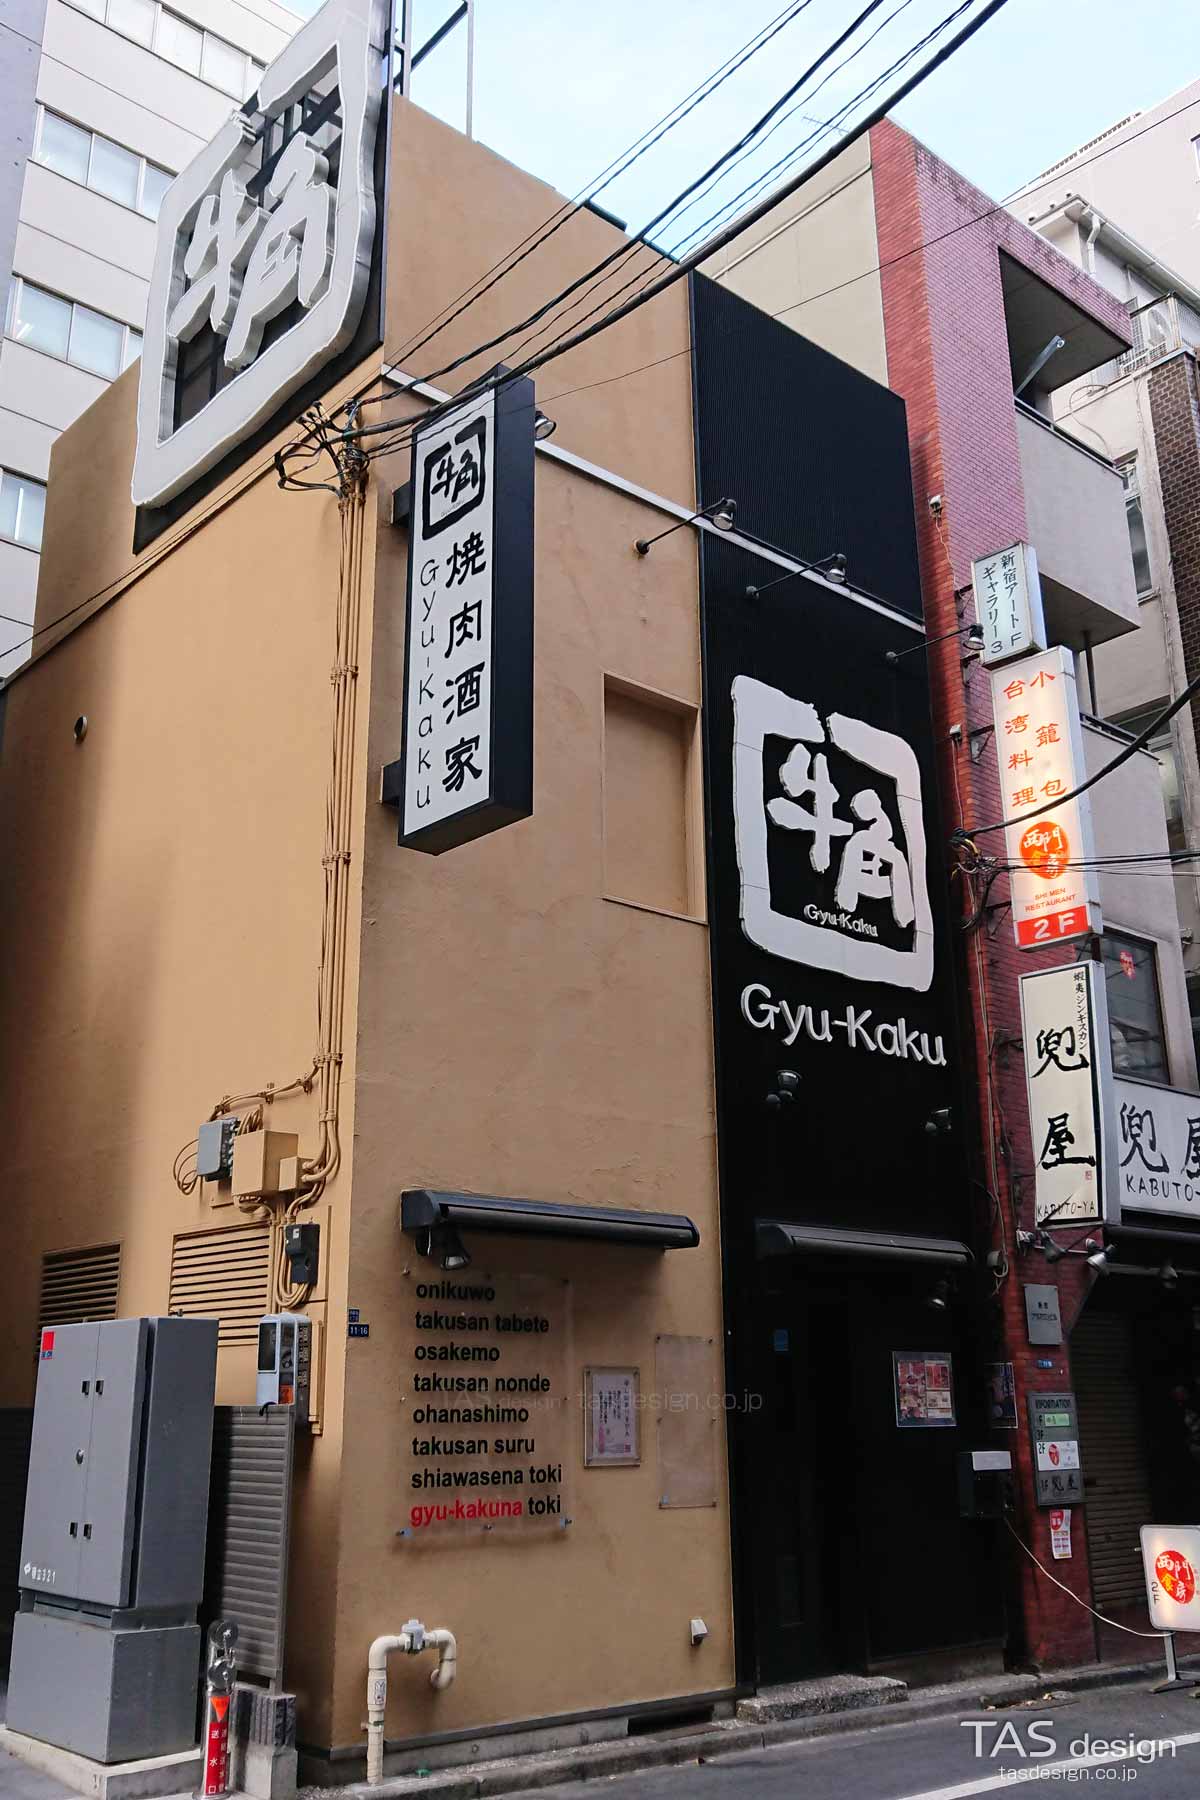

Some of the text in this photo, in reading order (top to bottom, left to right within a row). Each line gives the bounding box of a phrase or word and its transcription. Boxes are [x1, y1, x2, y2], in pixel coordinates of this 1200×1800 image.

[166, 131, 336, 368] 牛角
[431, 449, 478, 502] 牛角
[983, 563, 999, 638] ギャラリー
[1001, 552, 1020, 628] 新宿アート
[443, 532, 487, 792] 焼肉酒家
[1003, 680, 1037, 807] 台湾料理
[1030, 671, 1067, 797] 小籠包
[767, 742, 915, 928] 牛角
[804, 903, 878, 937] Gyu-Kaku
[1025, 895, 1076, 912] RESTAURANT
[740, 983, 947, 1066] Gyu-Kaku
[1030, 1026, 1096, 1170] 兜屋
[416, 1281, 495, 1300] onikuwo
[415, 1311, 549, 1333] takusan tabete
[415, 1342, 500, 1361] osakemo
[414, 1372, 550, 1392] takusan nonde
[413, 1404, 529, 1423] ohanashimo
[412, 1436, 535, 1456] takusan suru
[411, 1464, 562, 1488] shiawasena toki
[411, 1495, 561, 1527] gyu-kakuna toki
[209, 1730, 220, 1794] 送水口
